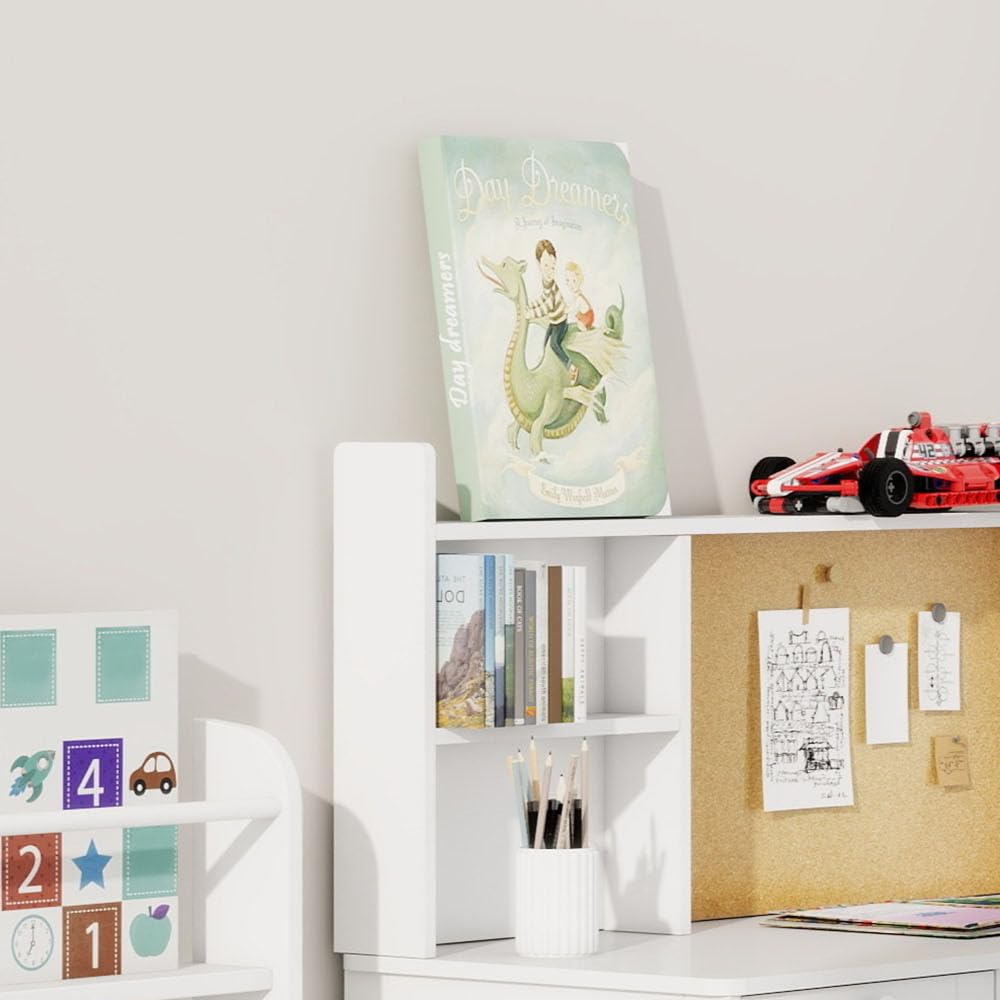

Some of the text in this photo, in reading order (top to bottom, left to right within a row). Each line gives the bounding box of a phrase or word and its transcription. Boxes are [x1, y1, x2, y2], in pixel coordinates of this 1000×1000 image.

[454, 147, 631, 225] Day Dreamers
[438, 251, 472, 408] Day dreamers
[920, 444, 935, 458] 42
[77, 758, 105, 806] 4
[18, 844, 43, 895] 2
[85, 922, 101, 969] 1
